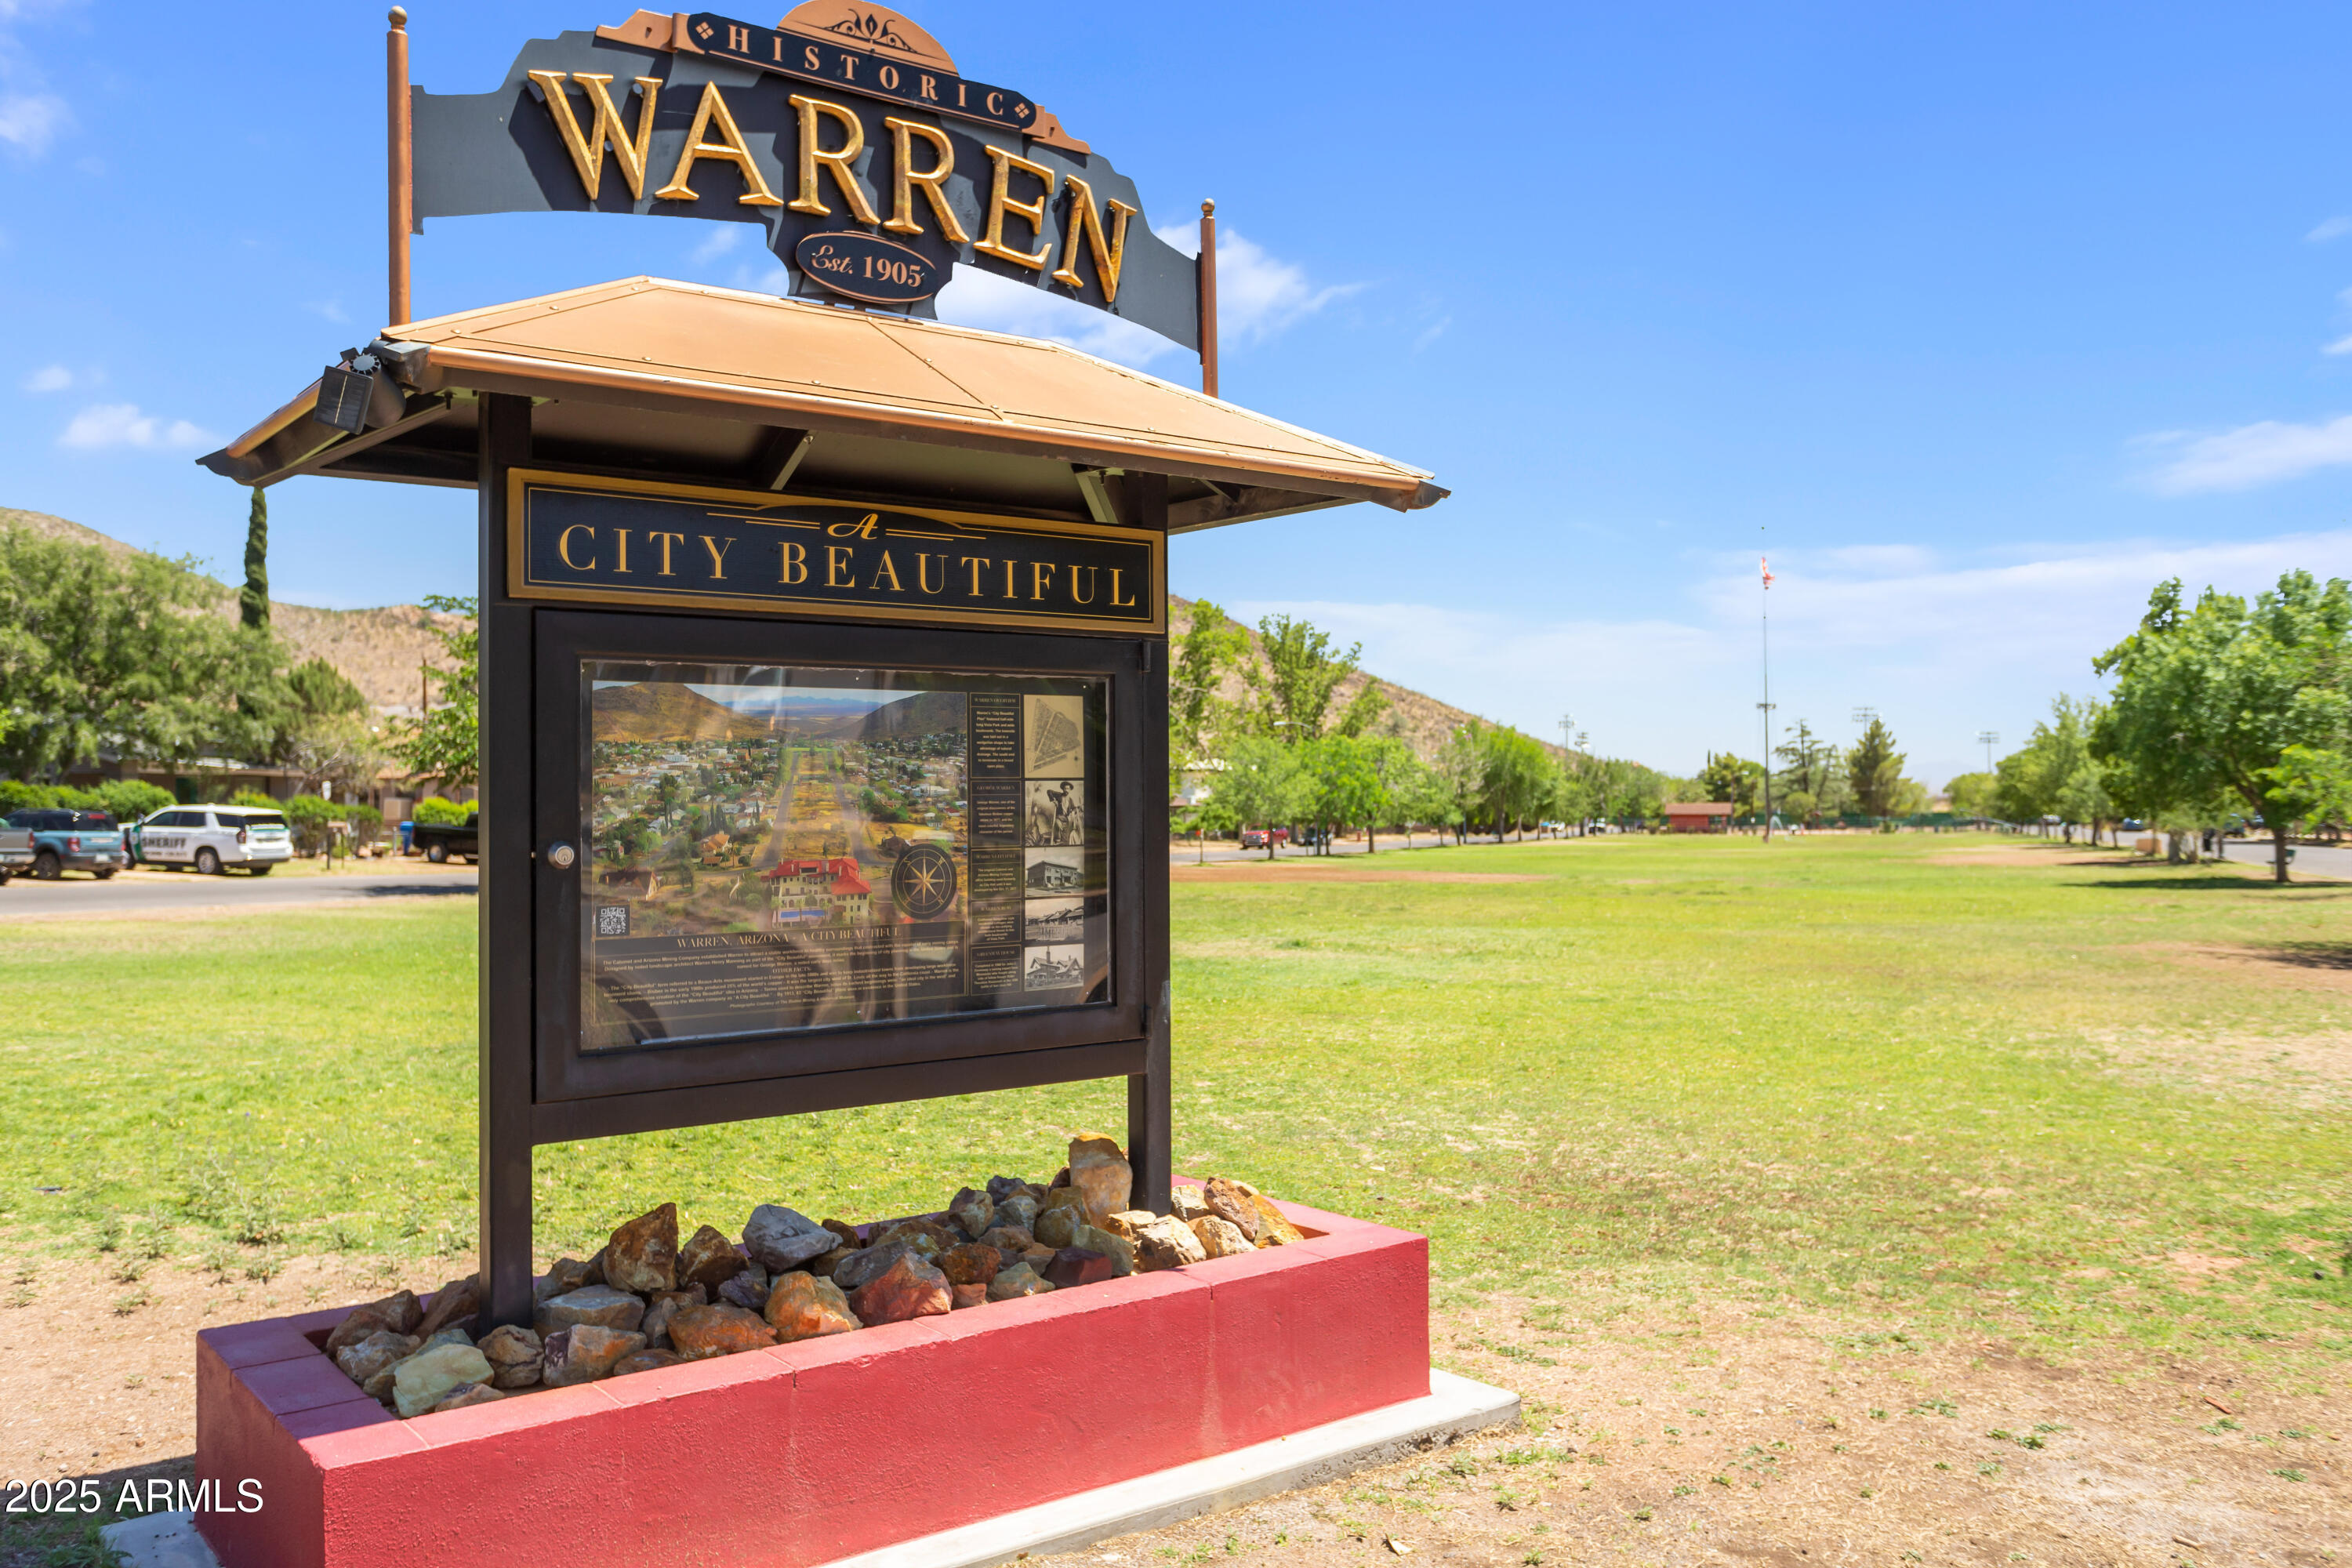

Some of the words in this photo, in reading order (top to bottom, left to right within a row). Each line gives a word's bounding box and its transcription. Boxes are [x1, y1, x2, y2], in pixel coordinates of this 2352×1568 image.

[726, 24, 1006, 116] HISTORIC
[527, 69, 1138, 303] WARREN
[811, 245, 853, 274] Est.
[863, 256, 922, 287] 1905
[827, 513, 880, 540] A
[558, 524, 738, 579] CITY
[779, 542, 1136, 607] BEAUTIFUL
[141, 836, 187, 848] SHERIFF
[739, 933, 789, 946] ARIZONA
[811, 931, 836, 941] CITY
[840, 927, 902, 939] BEAUTIFUL
